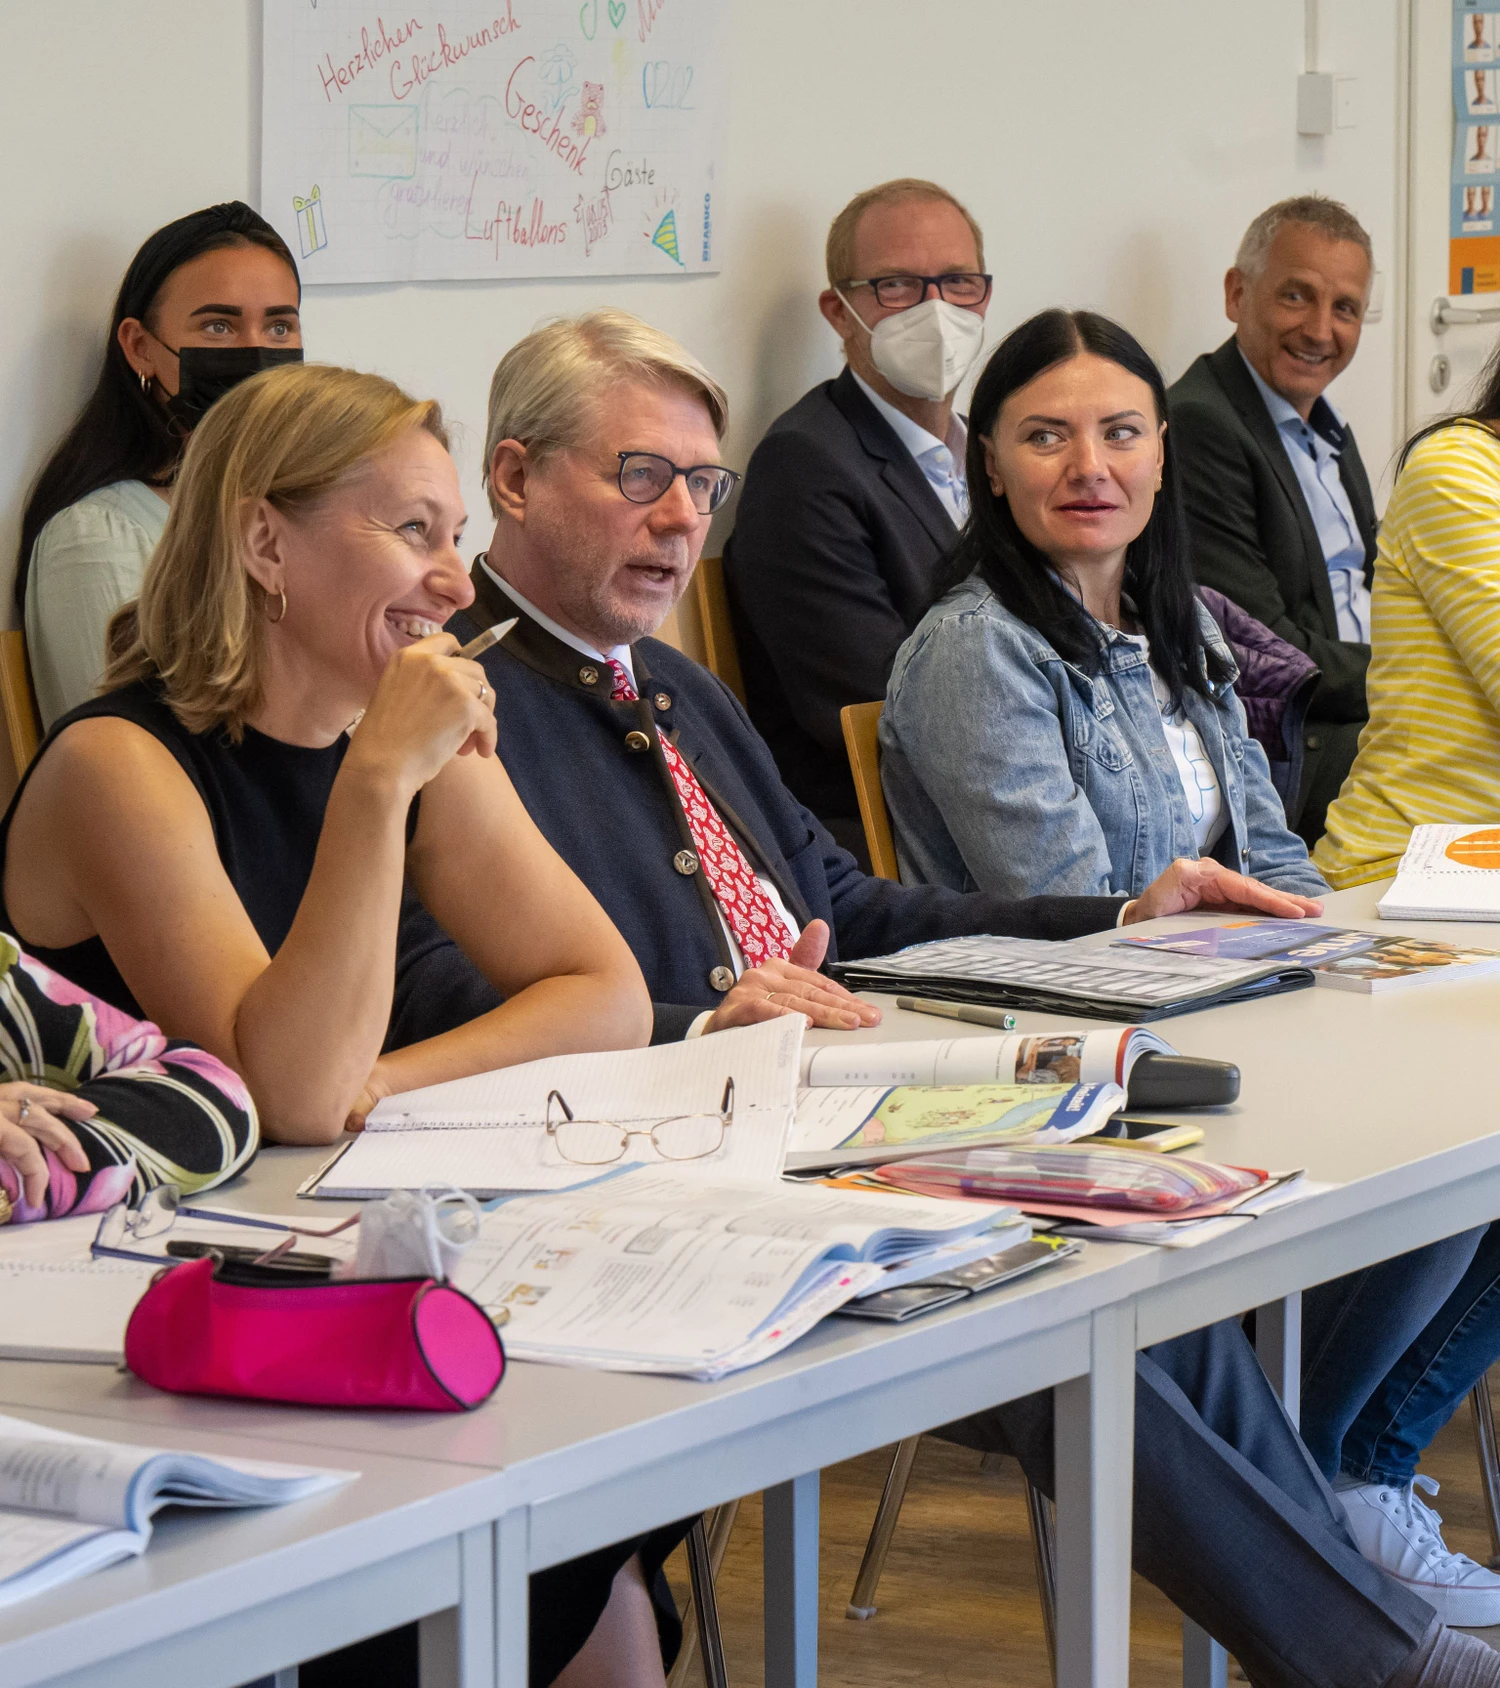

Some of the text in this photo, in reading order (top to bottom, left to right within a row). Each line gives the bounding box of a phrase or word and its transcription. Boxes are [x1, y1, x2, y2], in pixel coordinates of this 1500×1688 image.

[317, 17, 423, 103] Herzlichen
[390, 0, 521, 100] Glückwunsch
[505, 56, 592, 176] Geschenk
[465, 169, 567, 262] Luftballons
[602, 149, 656, 191] Gäste
